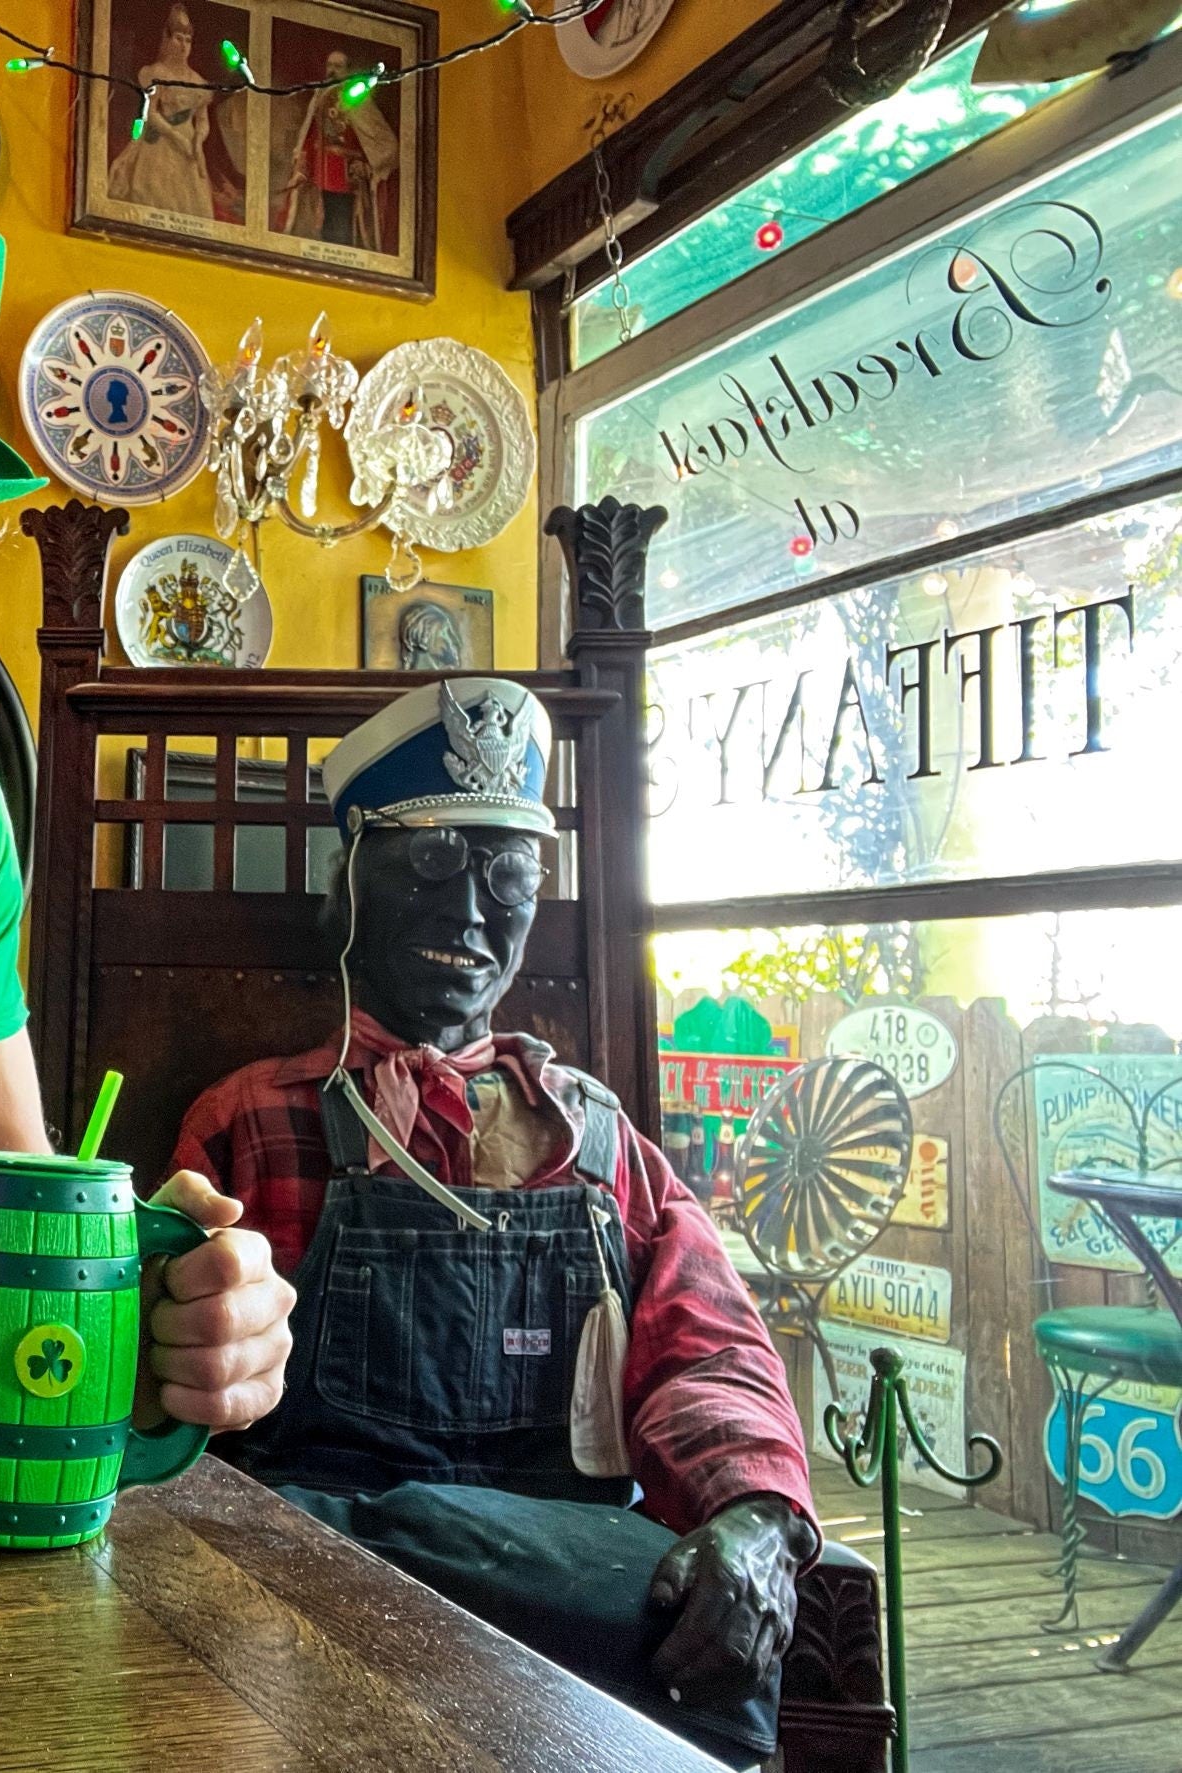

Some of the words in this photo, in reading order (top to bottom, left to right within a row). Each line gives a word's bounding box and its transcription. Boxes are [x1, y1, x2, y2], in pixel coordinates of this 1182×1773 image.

[140, 543, 173, 568] Queen
[176, 540, 229, 566] Elizabeth
[870, 1013, 906, 1045] 418
[1041, 1086, 1097, 1138] PUMP
[871, 1260, 905, 1277] OHIO
[837, 1274, 874, 1310] AYU
[884, 1281, 938, 1325] 9044
[1079, 1404, 1166, 1499] 66
